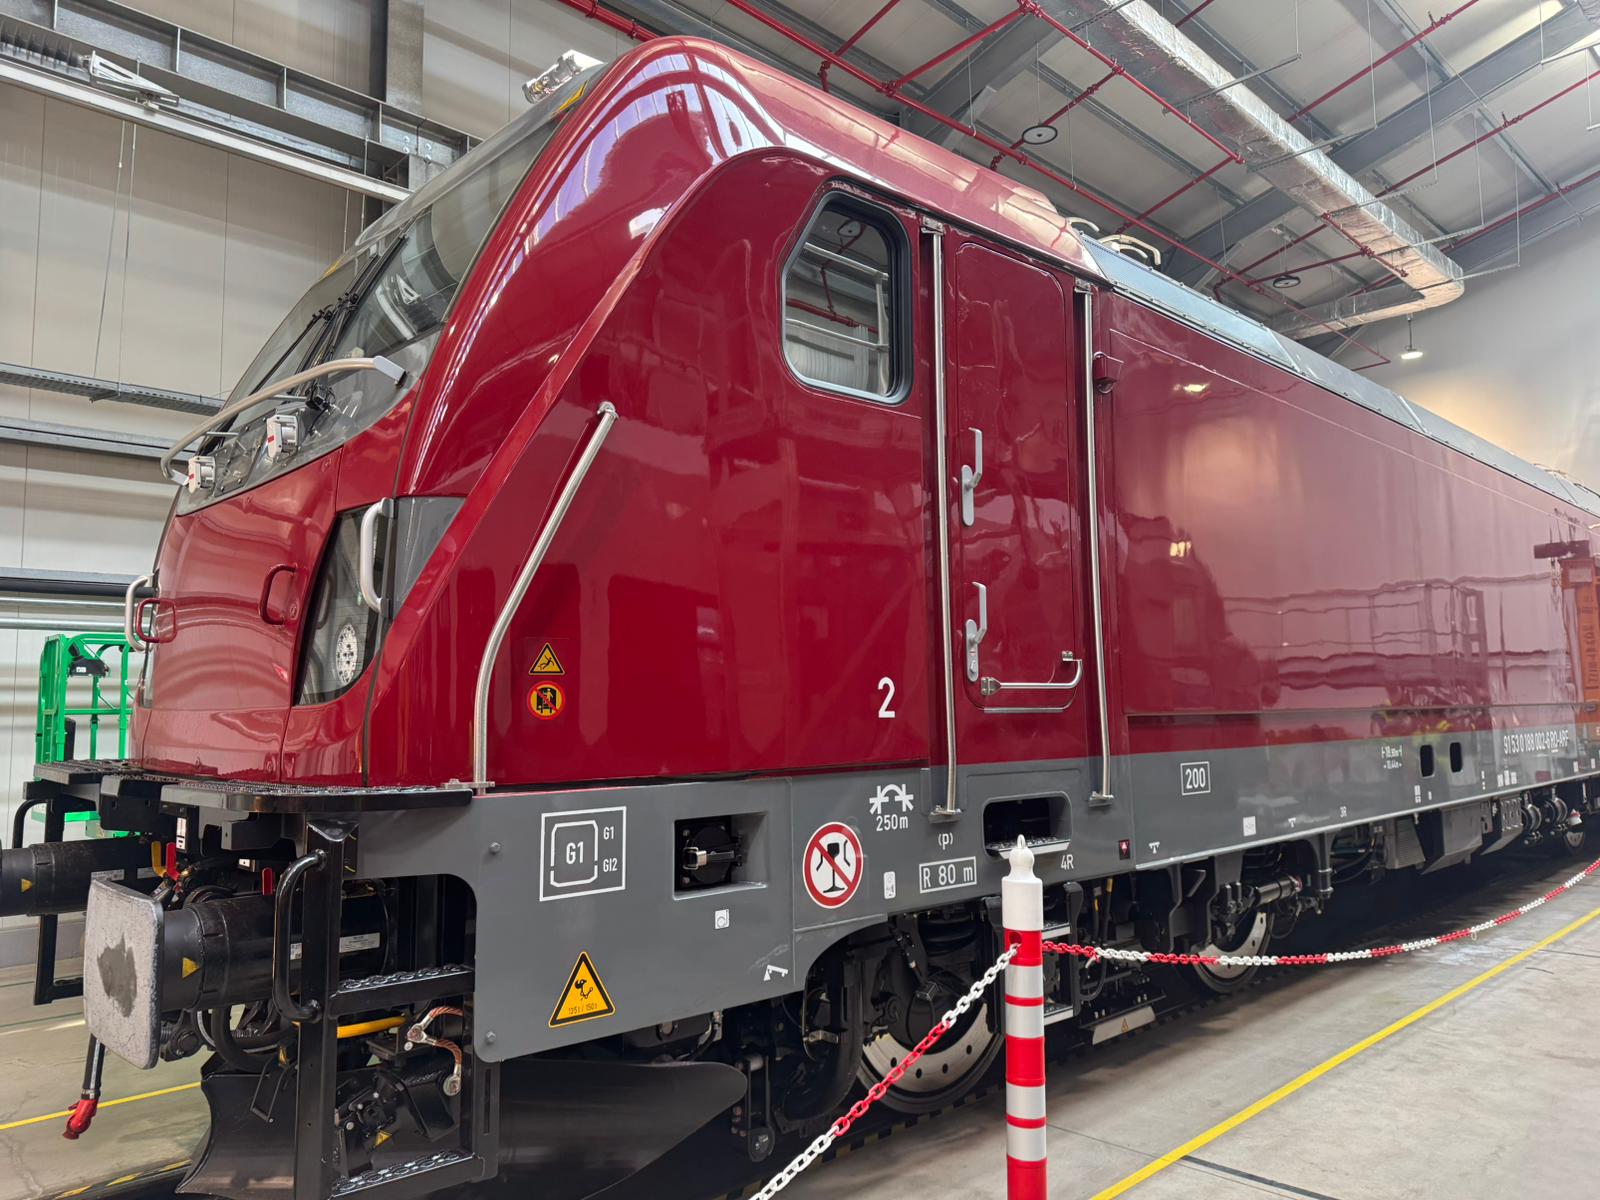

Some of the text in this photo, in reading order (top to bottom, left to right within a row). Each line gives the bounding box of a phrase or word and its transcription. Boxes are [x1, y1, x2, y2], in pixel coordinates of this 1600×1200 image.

[877, 676, 896, 718] 2
[1503, 735, 1511, 754] 91
[1185, 767, 1206, 790] 200
[603, 826, 614, 840] G1
[938, 832, 953, 850] (p)
[566, 841, 584, 865] G1
[1060, 854, 1074, 870] 4R
[923, 864, 973, 888] R 80 m
